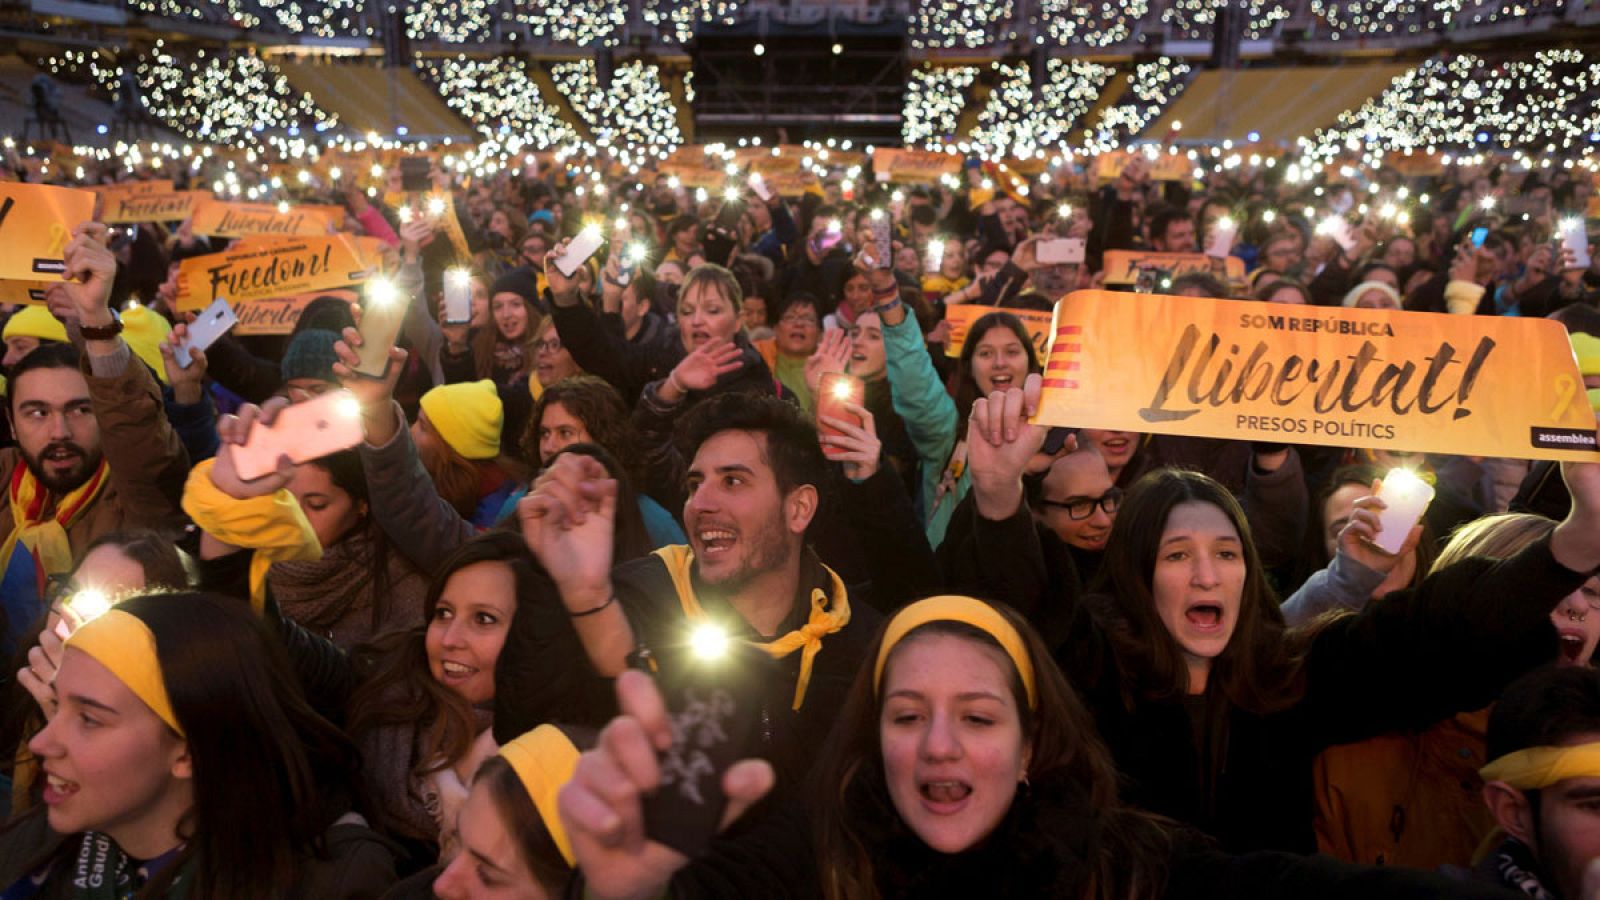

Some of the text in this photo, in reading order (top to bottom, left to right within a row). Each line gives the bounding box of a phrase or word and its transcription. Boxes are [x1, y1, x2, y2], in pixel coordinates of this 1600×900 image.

[207, 245, 332, 300] Freedom!
[1240, 314, 1396, 337] SOM REPÚBLICA
[1137, 323, 1497, 423] Llibertat!
[1236, 414, 1396, 440] PRESOS POLÍTICS
[1539, 432, 1597, 445] assemblea
